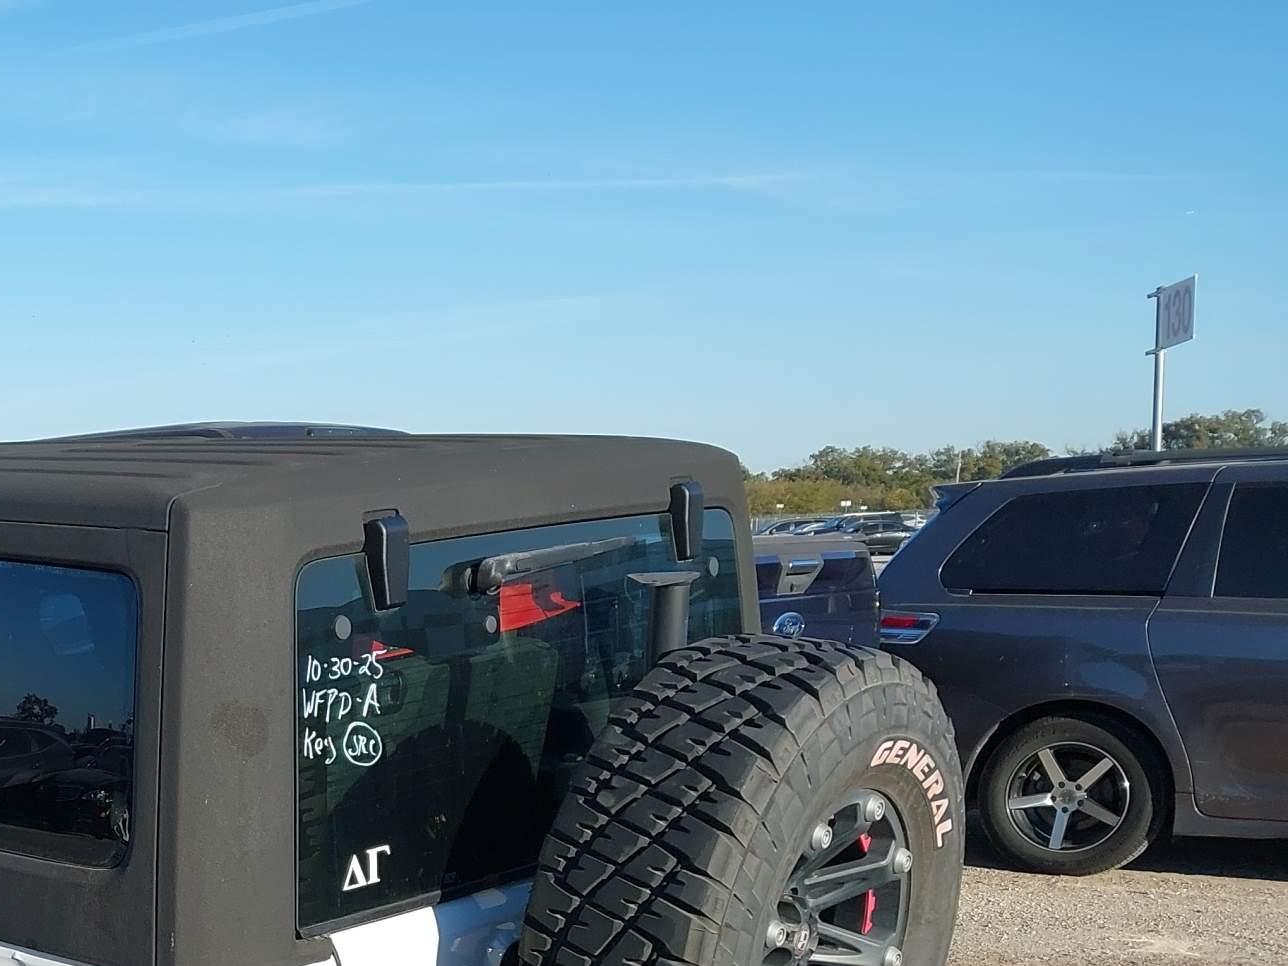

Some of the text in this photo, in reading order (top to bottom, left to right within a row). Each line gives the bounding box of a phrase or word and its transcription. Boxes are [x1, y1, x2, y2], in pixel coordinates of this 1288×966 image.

[1162, 286, 1192, 339] 130
[303, 727, 337, 764] Key
[870, 740, 953, 848] GENERAL
